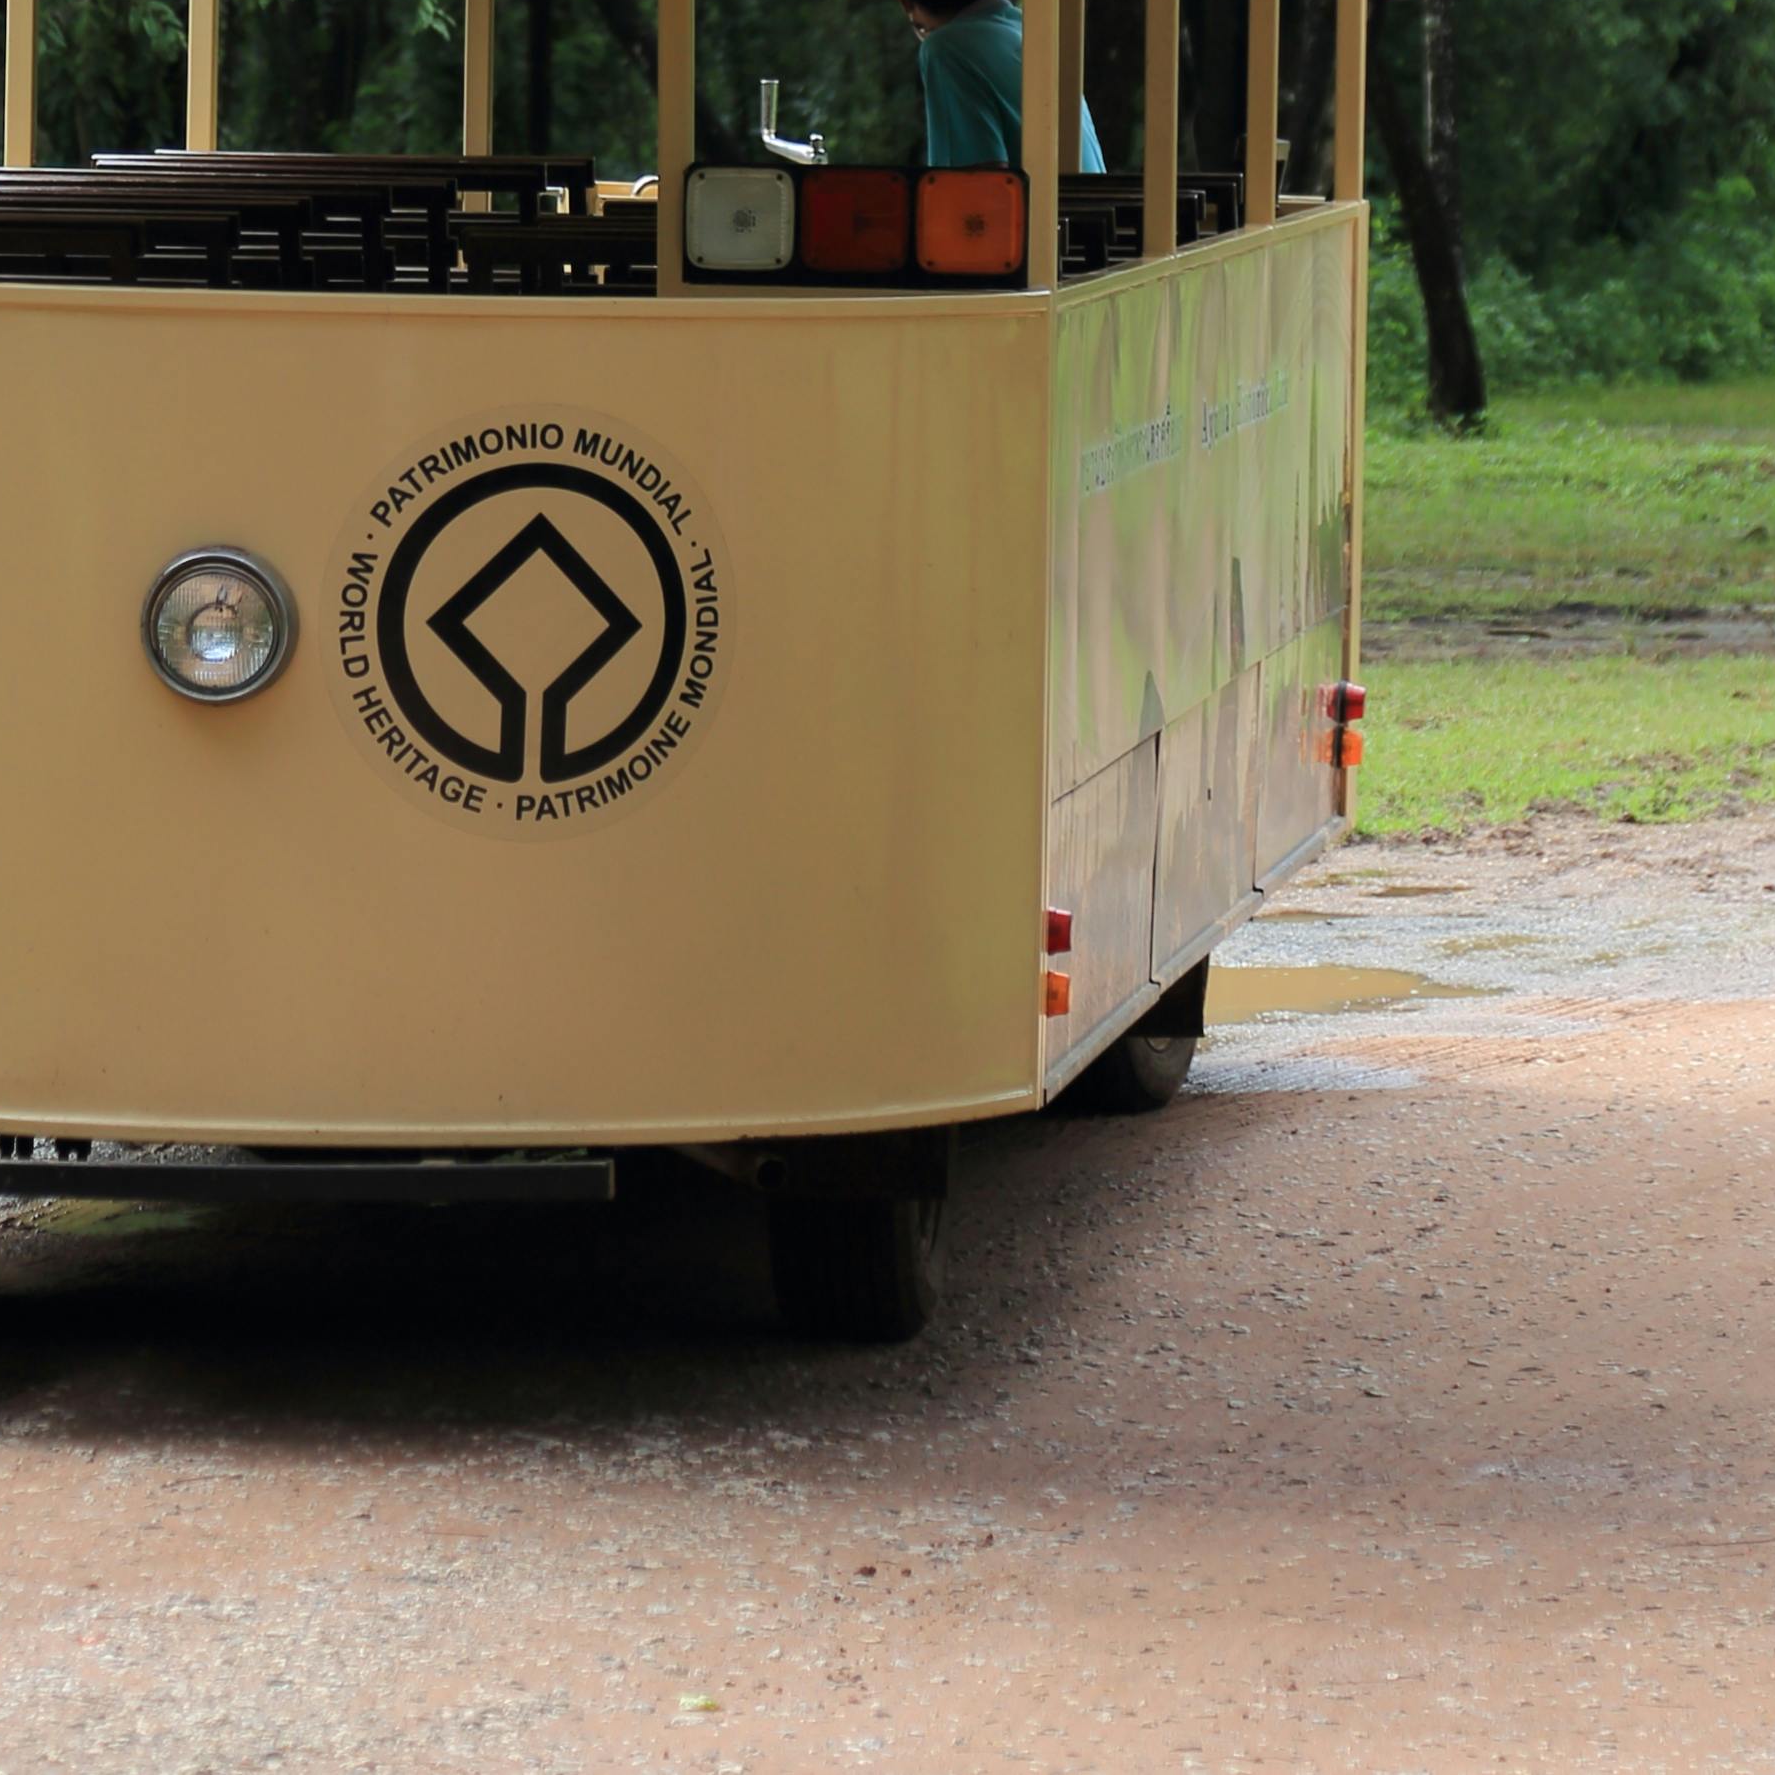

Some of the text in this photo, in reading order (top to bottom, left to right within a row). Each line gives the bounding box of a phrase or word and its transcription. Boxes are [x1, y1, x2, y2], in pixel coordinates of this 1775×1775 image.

[369, 423, 692, 536] PATRIMONIO MUNDIAL
[339, 551, 488, 813] WORLD HERITAGE
[515, 548, 719, 821] PATRIMOINE MONDIAL
